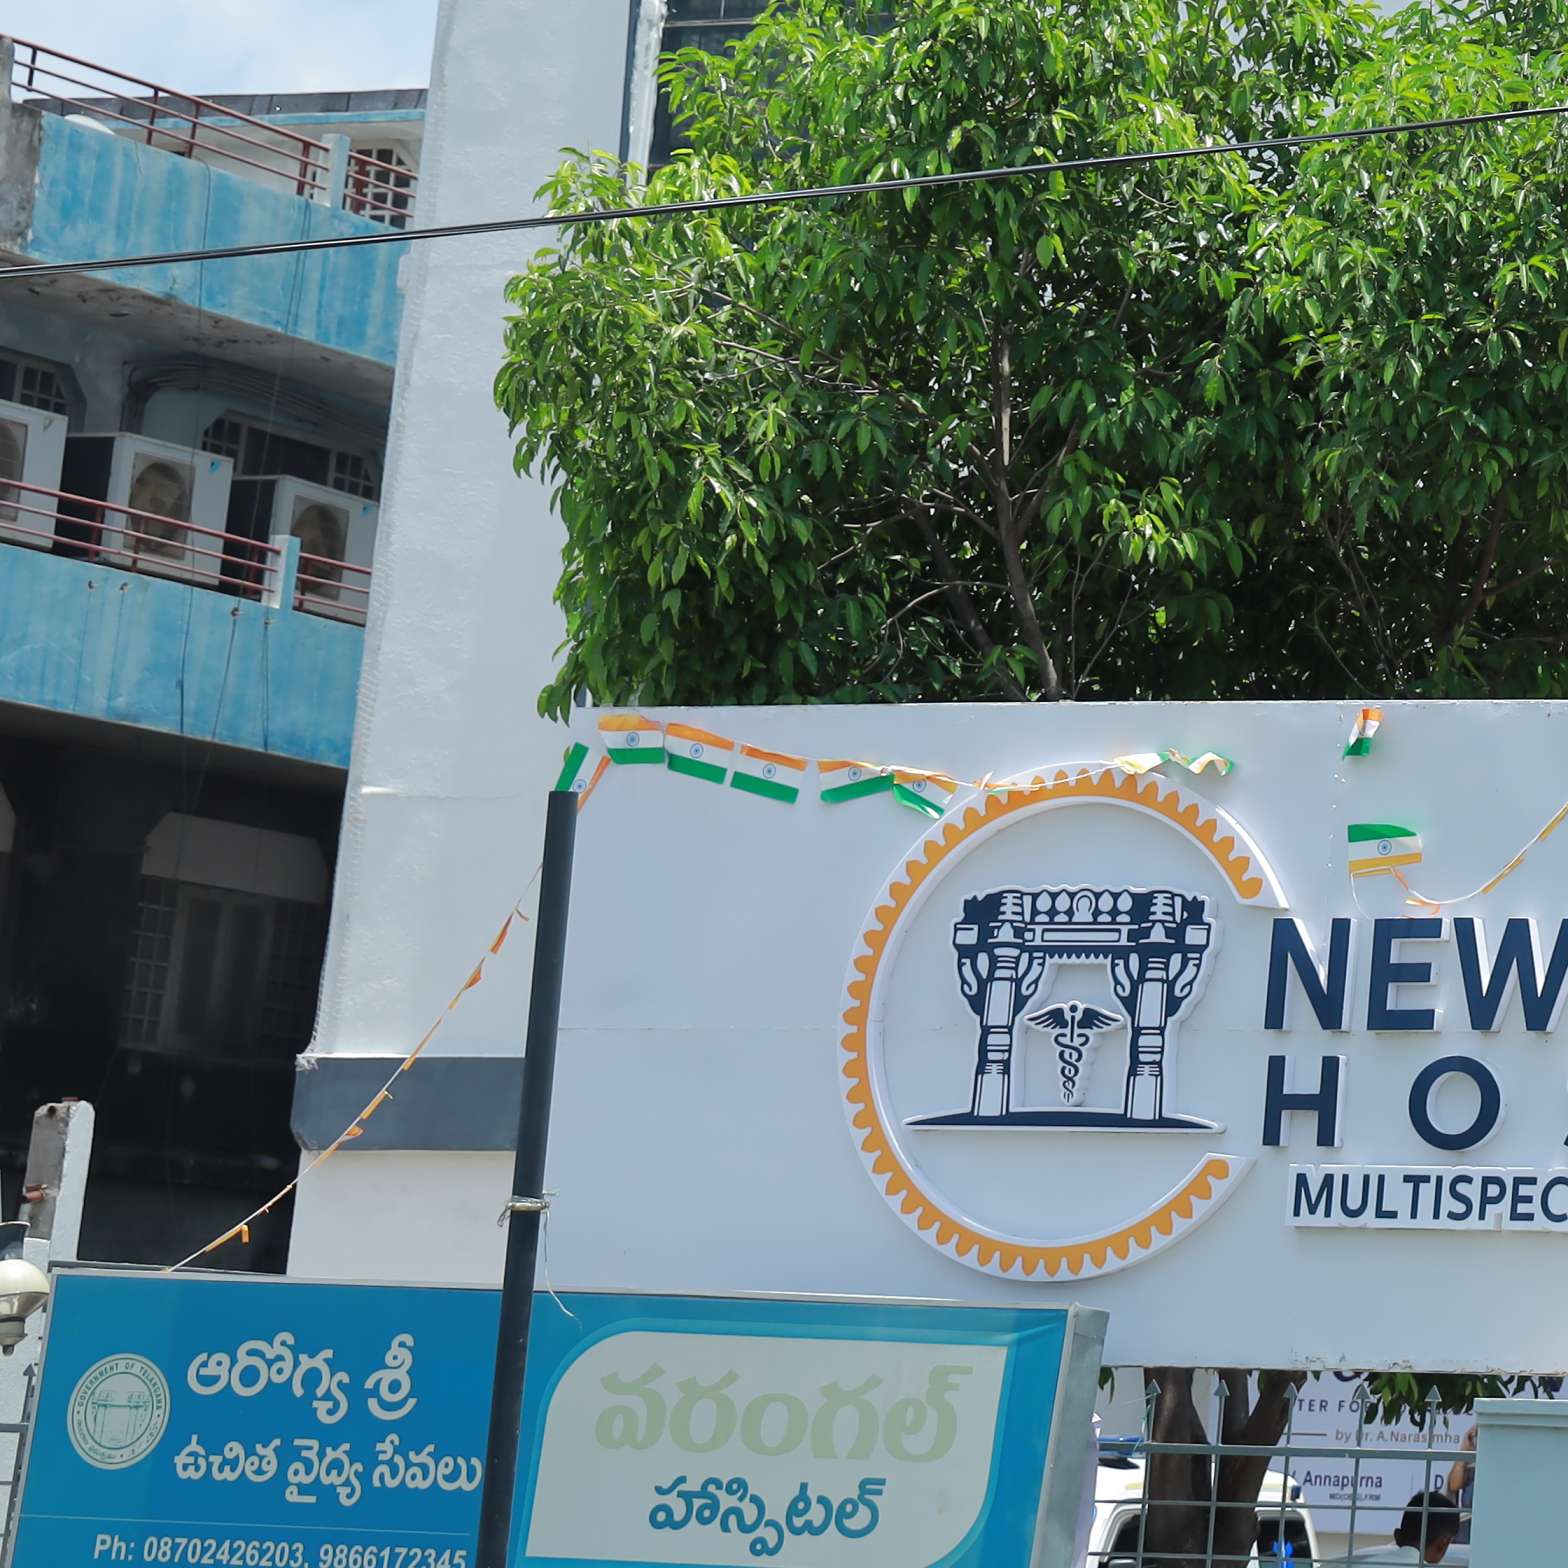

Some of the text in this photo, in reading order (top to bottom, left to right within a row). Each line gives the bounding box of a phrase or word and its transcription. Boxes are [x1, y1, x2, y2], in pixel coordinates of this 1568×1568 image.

[187, 1331, 418, 1424] ఆరోగ్య శ్రీ
[594, 1362, 974, 1463] వరంగల్
[174, 1434, 281, 1482] ఉచిత
[285, 1438, 363, 1506] వైద్య
[372, 1433, 483, 1492] సేవలు
[93, 1534, 135, 1561] Ph:
[318, 1543, 468, 1568] 9866172345
[648, 1475, 887, 1557] హాస్పిటల్
